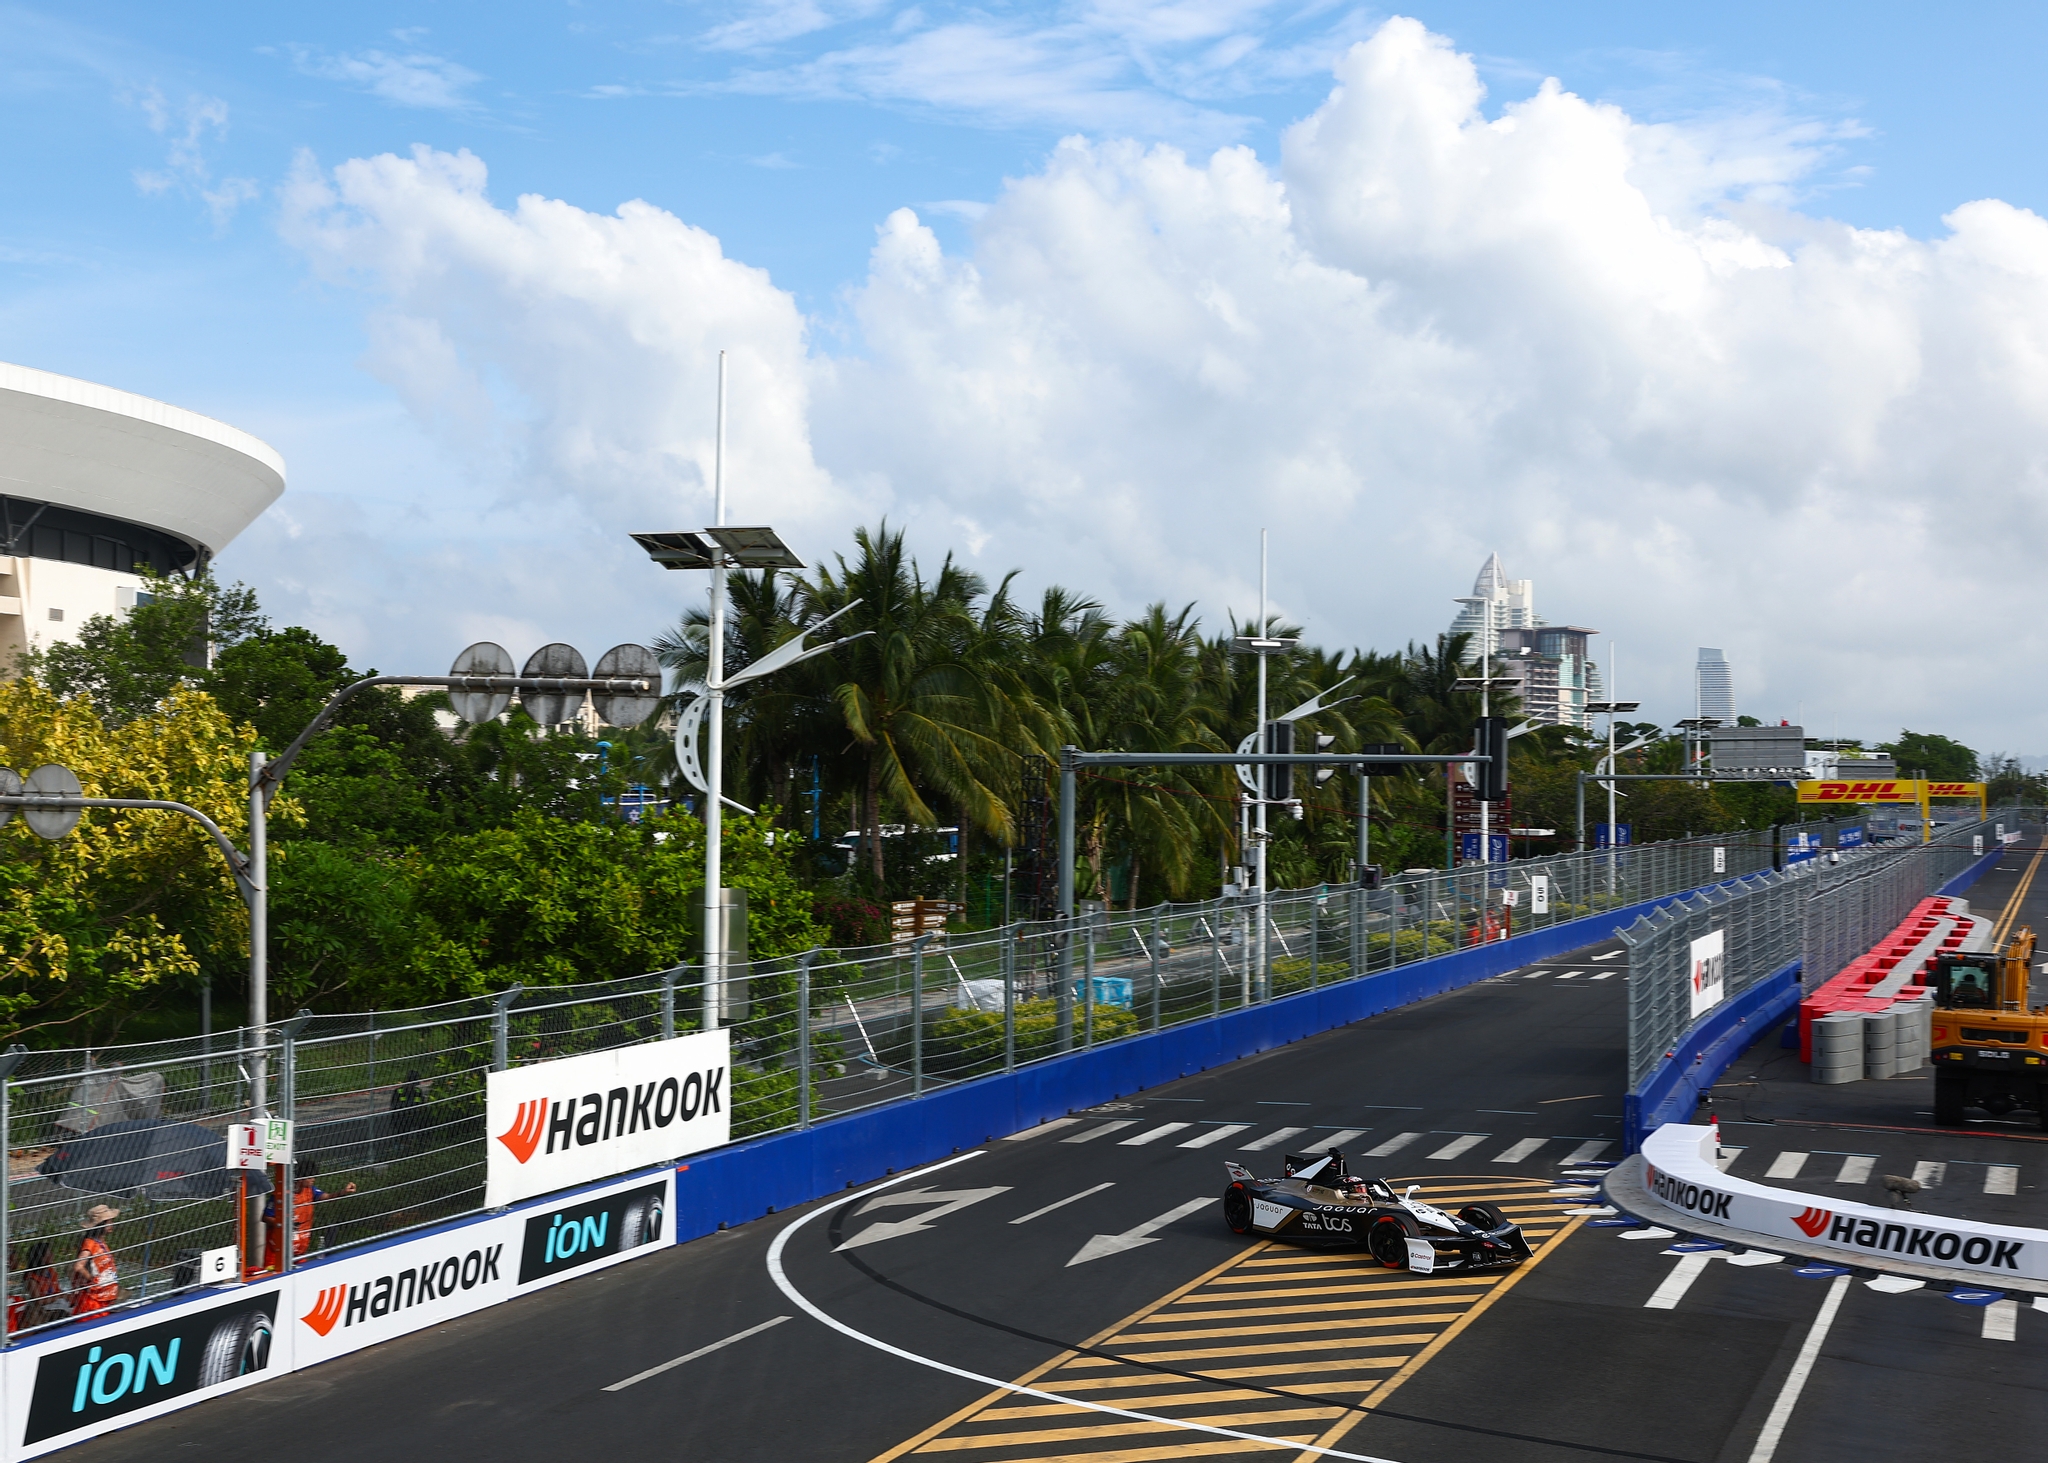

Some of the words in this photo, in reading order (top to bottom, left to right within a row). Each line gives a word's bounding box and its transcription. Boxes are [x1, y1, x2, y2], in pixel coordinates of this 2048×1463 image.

[1818, 783, 1901, 800] DHL
[1928, 784, 1969, 795] DHL
[266, 1142, 287, 1151] EXIT
[240, 1148, 263, 1157] FIRE
[1302, 1222, 1323, 1230] TATA
[215, 1256, 225, 1272] 6
